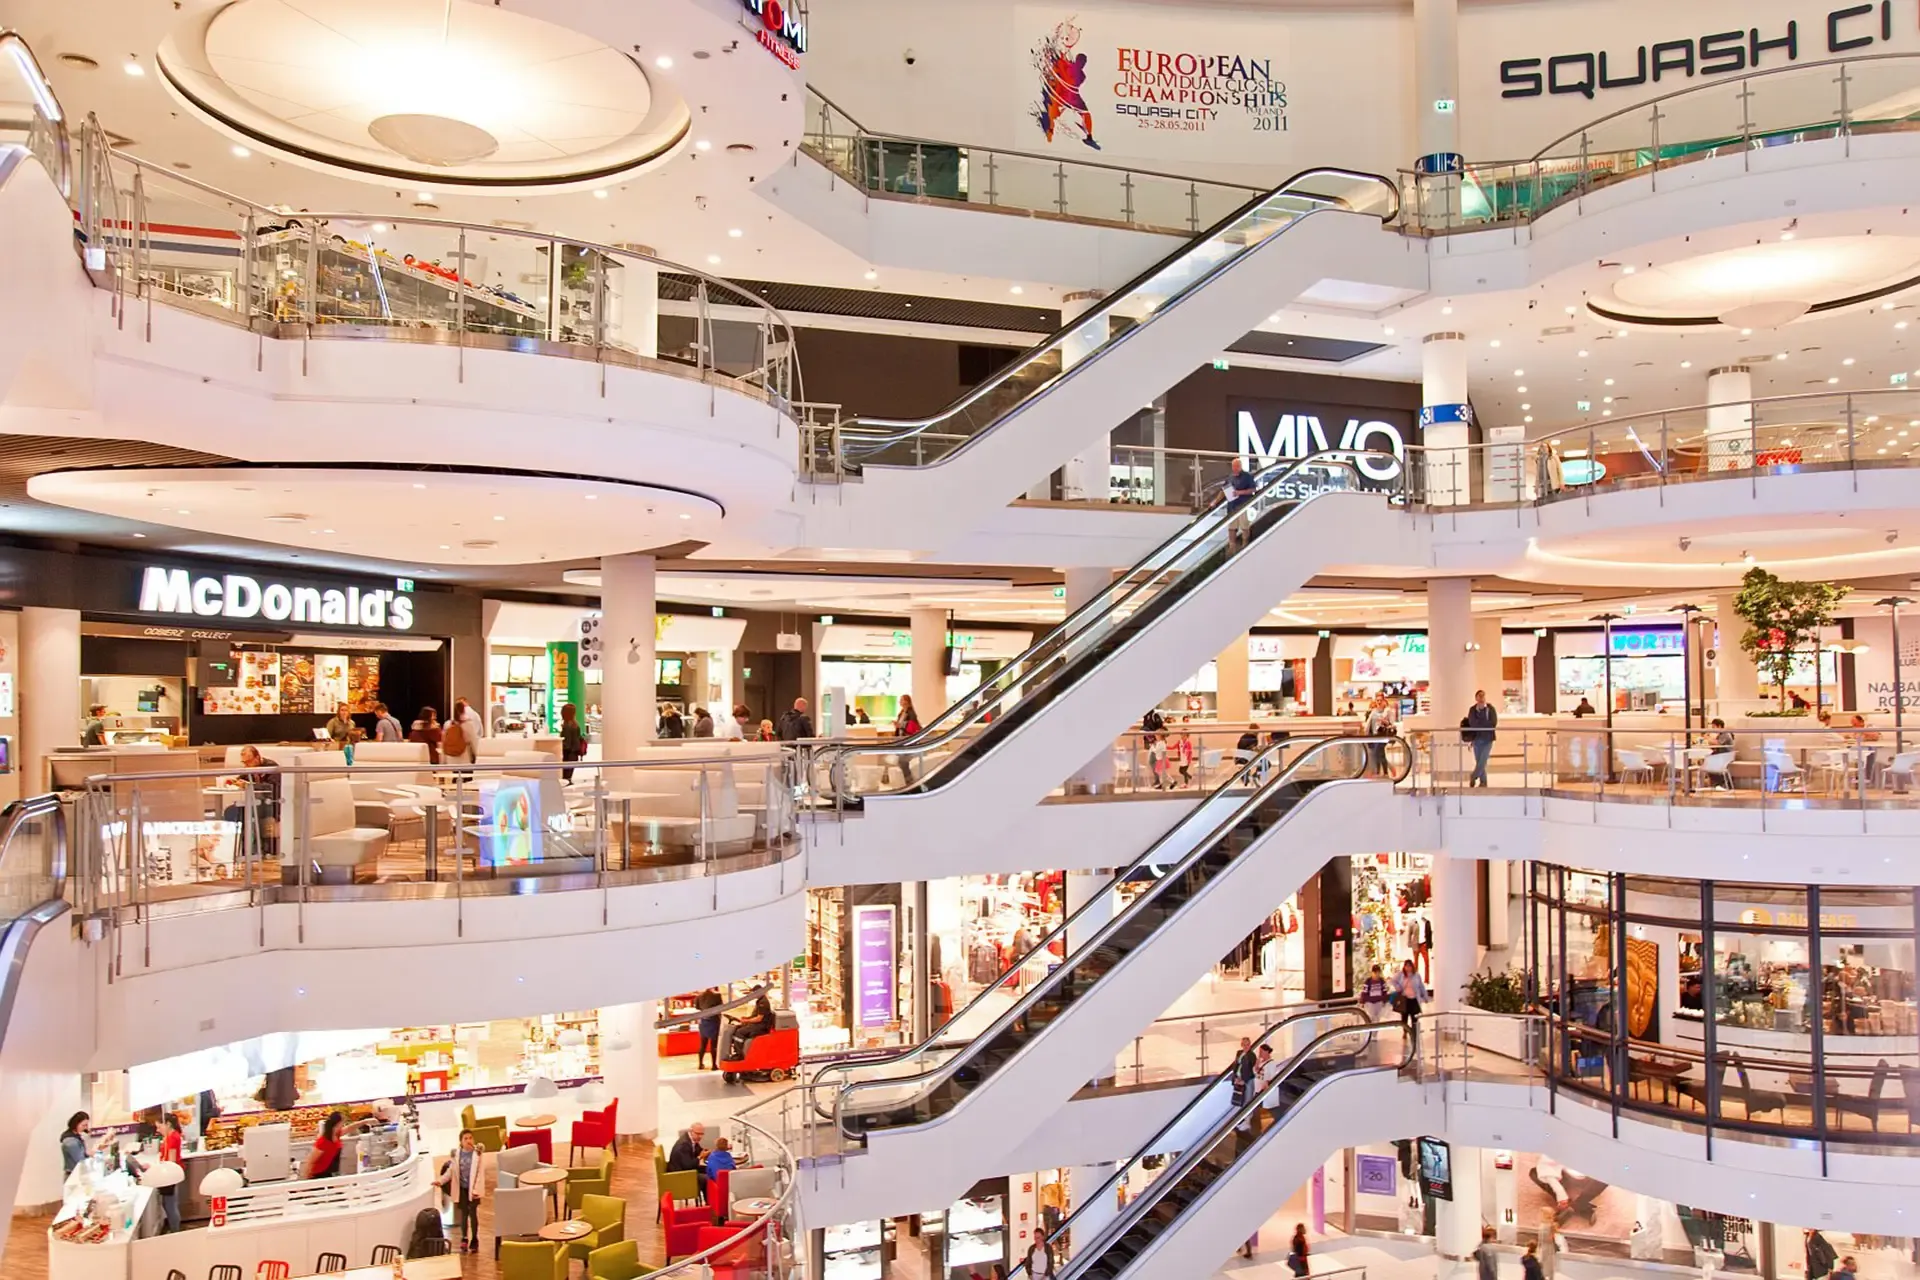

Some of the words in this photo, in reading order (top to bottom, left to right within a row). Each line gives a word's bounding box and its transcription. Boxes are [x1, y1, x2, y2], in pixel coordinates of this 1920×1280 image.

[1500, 19, 1798, 99] SQUASH
[1826, 0, 1920, 53] CI
[1116, 47, 1271, 82] EUROPEAN
[1125, 71, 1221, 91] INDIVIDUAL
[1225, 78, 1286, 94] CLOSED
[1113, 82, 1288, 108] CHAMPIONSHIPS
[1116, 104, 1181, 118] SQUASH
[1186, 107, 1218, 121] CITY
[1252, 116, 1288, 131] 2011
[1138, 118, 1206, 132] 25-28.05.2011
[1237, 410, 1404, 481] MIVO
[138, 566, 414, 630] McDonald's
[191, 630, 232, 640] COLLECT
